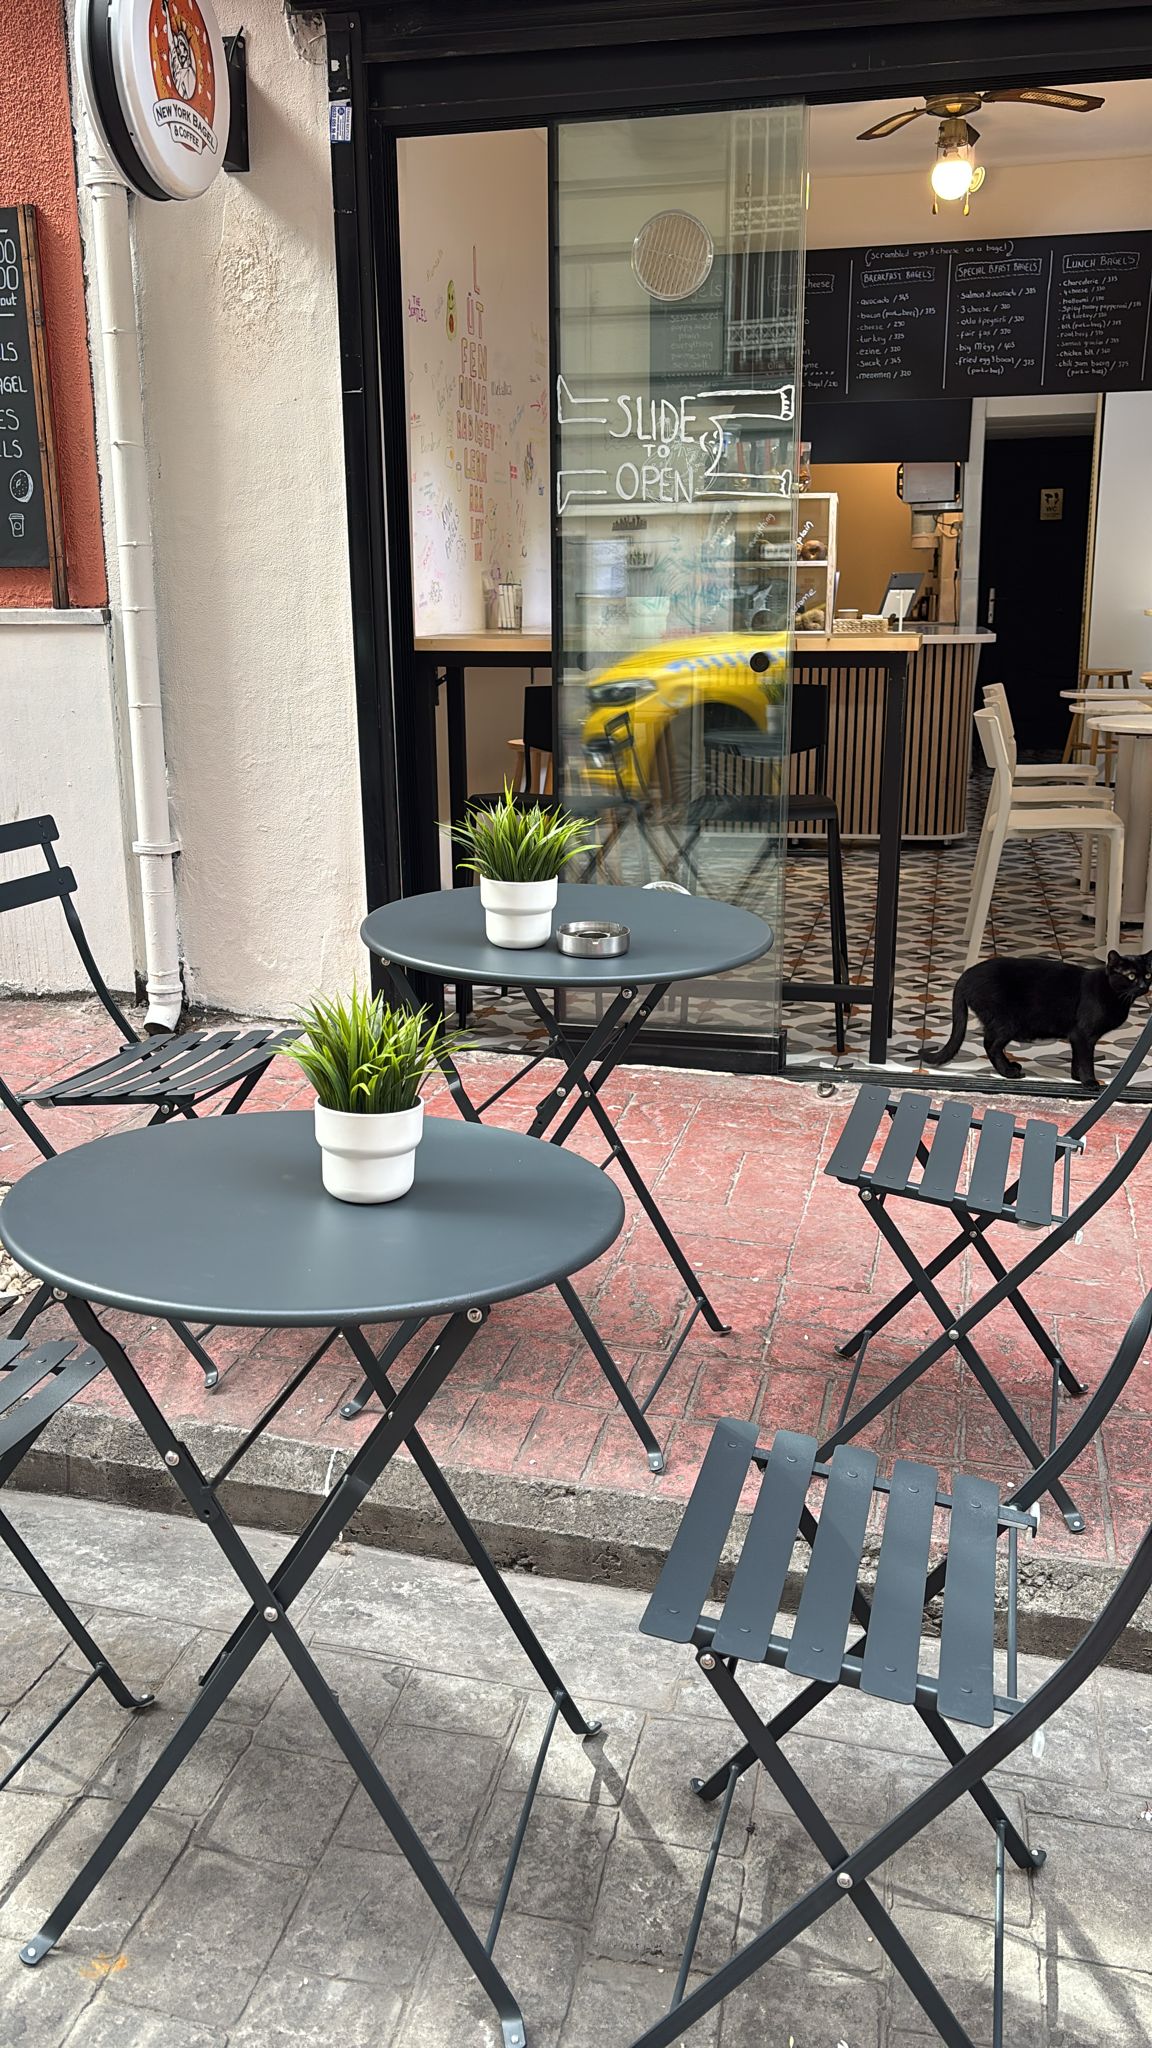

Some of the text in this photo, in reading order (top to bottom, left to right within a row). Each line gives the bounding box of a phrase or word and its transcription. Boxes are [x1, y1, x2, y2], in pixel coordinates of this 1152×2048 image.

[155, 104, 216, 149] NEW YORK BAGEL
[178, 128, 201, 148] COFFEE
[986, 242, 1007, 254] bagel
[1065, 255, 1136, 269] LUNCH BAGELS
[958, 265, 986, 278] SPECIAL
[1013, 262, 1038, 272] BAGELS
[804, 279, 831, 289] heese
[863, 271, 932, 284] BREAKFAST BAGELS
[701, 310, 719, 320] seed
[967, 305, 991, 314] cheese
[860, 334, 887, 346] turkey
[859, 348, 882, 356] ezine
[959, 343, 972, 354] big
[461, 337, 488, 381] FEN
[959, 355, 978, 366] fried
[609, 395, 697, 443] SLIDE
[642, 445, 671, 459] TO
[615, 462, 694, 504] OPEN
[796, 520, 815, 547] plain
